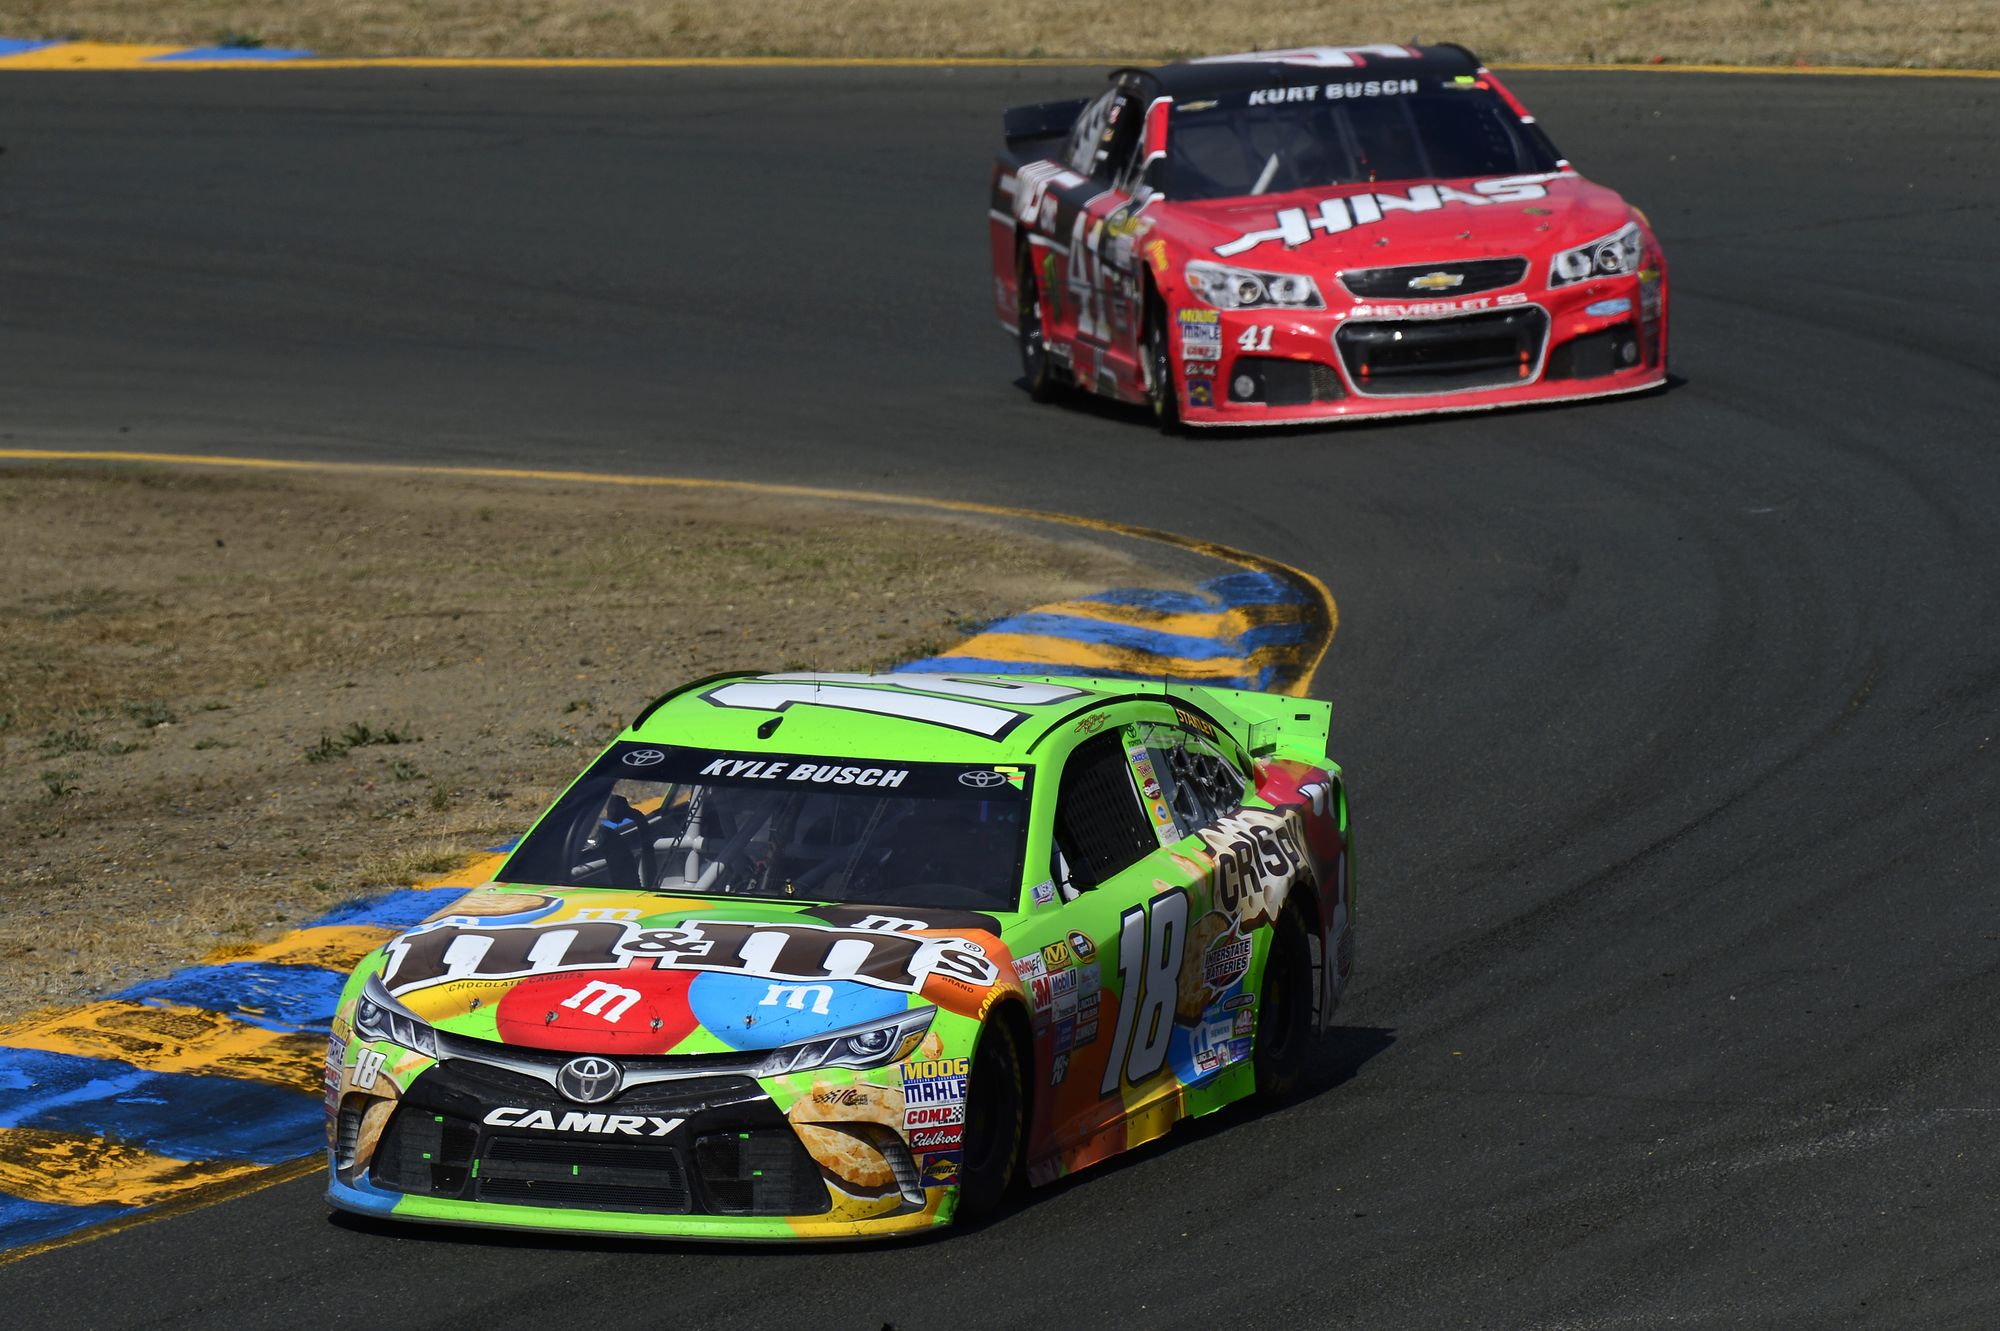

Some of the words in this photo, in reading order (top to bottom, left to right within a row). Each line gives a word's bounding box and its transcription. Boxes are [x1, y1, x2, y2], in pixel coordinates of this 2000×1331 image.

[1249, 85, 1319, 106] KURT
[1325, 79, 1418, 100] BUSCH
[1352, 298, 1491, 317] CHEVROLET
[1497, 292, 1528, 306] SS
[1238, 324, 1274, 352] 41
[1175, 708, 1215, 737] STANLEY
[700, 758, 789, 781] KYLE
[786, 763, 909, 788] BUSCH
[1206, 940, 1250, 966] INTERSTATE
[449, 980, 524, 992] CHOCOLATE
[528, 973, 585, 984] CANDIES
[1206, 958, 1248, 981] BATTERIES
[560, 980, 642, 1024] m
[759, 983, 834, 1015] m
[1031, 974, 1050, 1011] 3M
[1101, 887, 1188, 1095] 18
[351, 1048, 387, 1090] 18
[904, 1057, 969, 1081] MOOG
[904, 1080, 967, 1104] MAHLE
[483, 1107, 685, 1136] CAMRY
[907, 1107, 952, 1125] COMP
[911, 1128, 963, 1148] Edelbrock
